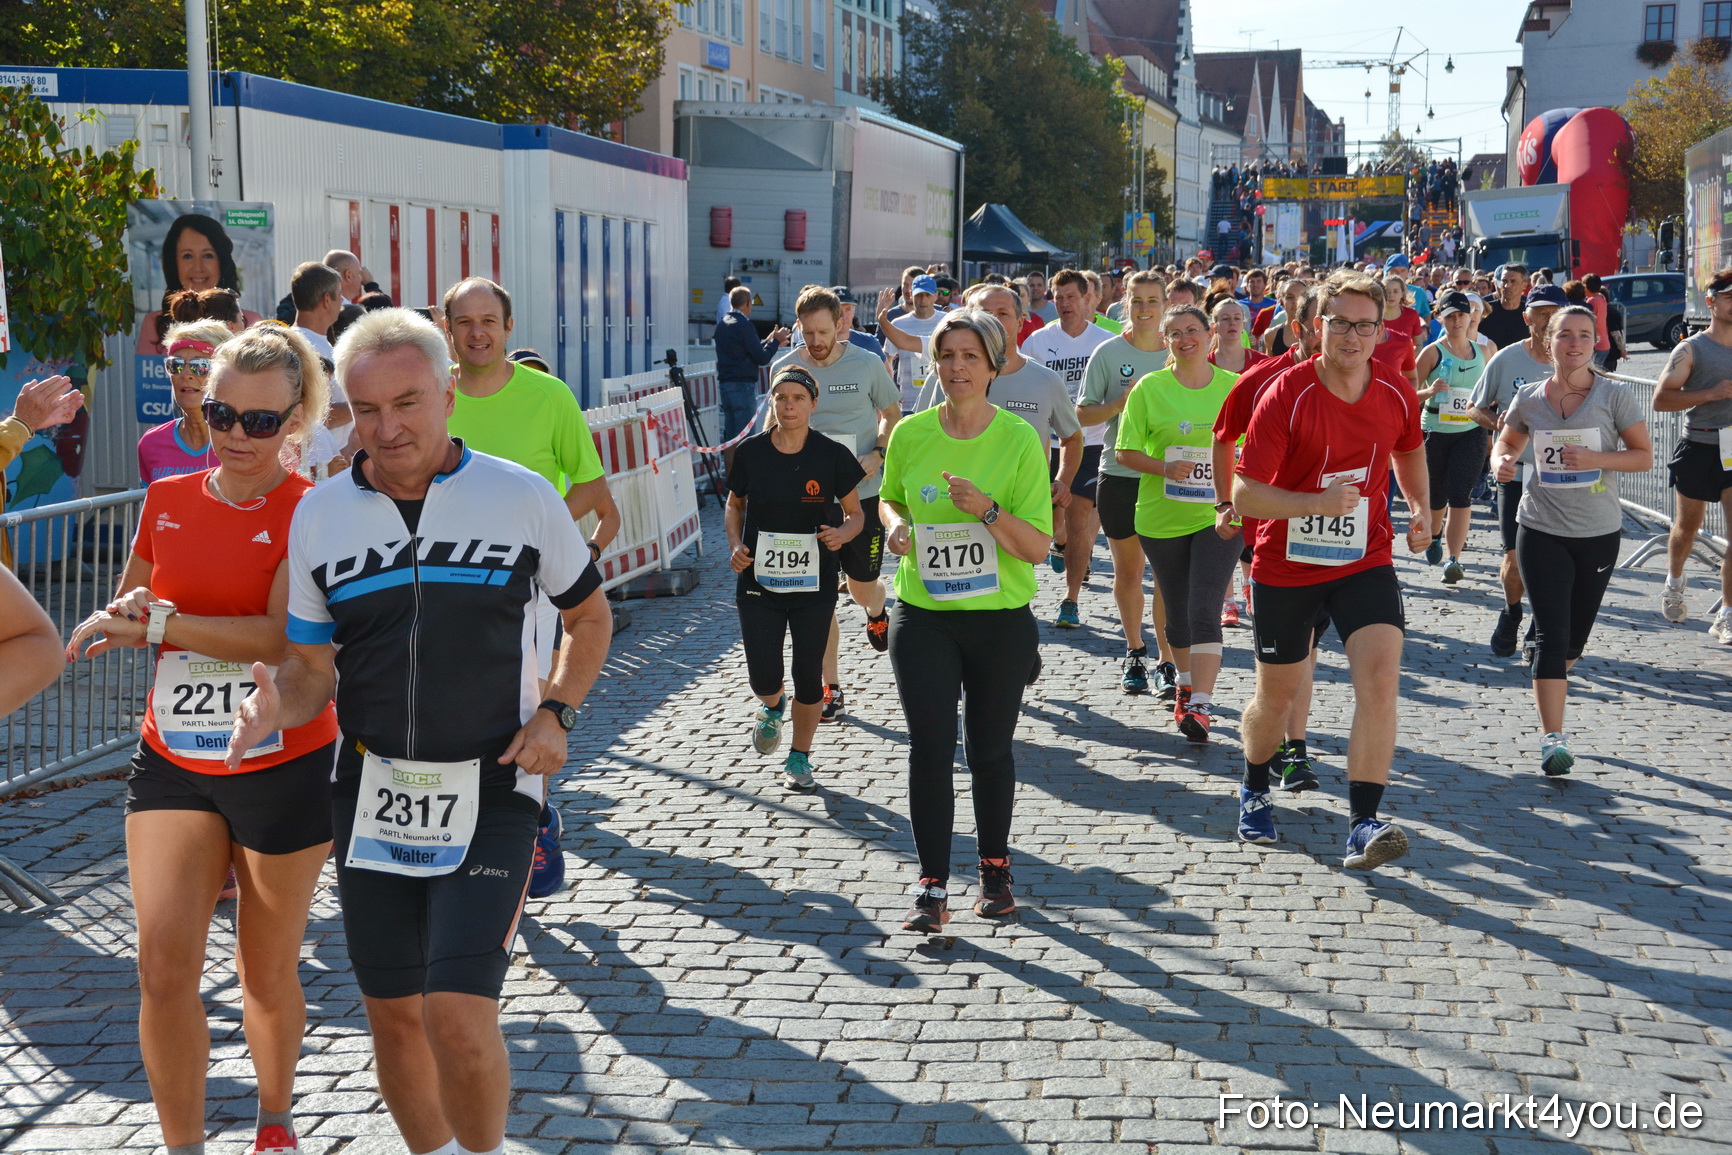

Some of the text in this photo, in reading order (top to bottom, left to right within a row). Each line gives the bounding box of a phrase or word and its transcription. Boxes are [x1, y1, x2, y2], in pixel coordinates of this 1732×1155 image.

[1308, 181, 1359, 194] START
[1493, 209, 1540, 221] BOCK
[142, 360, 171, 379] He
[828, 384, 858, 392] BOCK
[142, 402, 171, 416] CSU
[1006, 400, 1038, 410] BOCK
[1560, 474, 1576, 482] Lisa
[1178, 488, 1206, 496] Claudia
[1300, 515, 1355, 537] 3145
[935, 530, 970, 540] BOCK
[764, 550, 810, 568] 2194
[927, 542, 984, 568] 2170
[325, 537, 525, 588] DYNA
[945, 582, 970, 592] Petra
[189, 662, 242, 674] BOCK
[173, 682, 258, 715] 2217
[392, 768, 442, 785] BOCK
[375, 788, 458, 828] 2317
[380, 828, 440, 841] PARTL Neumarkt
[390, 846, 436, 864] Walter
[482, 868, 509, 878] asics
